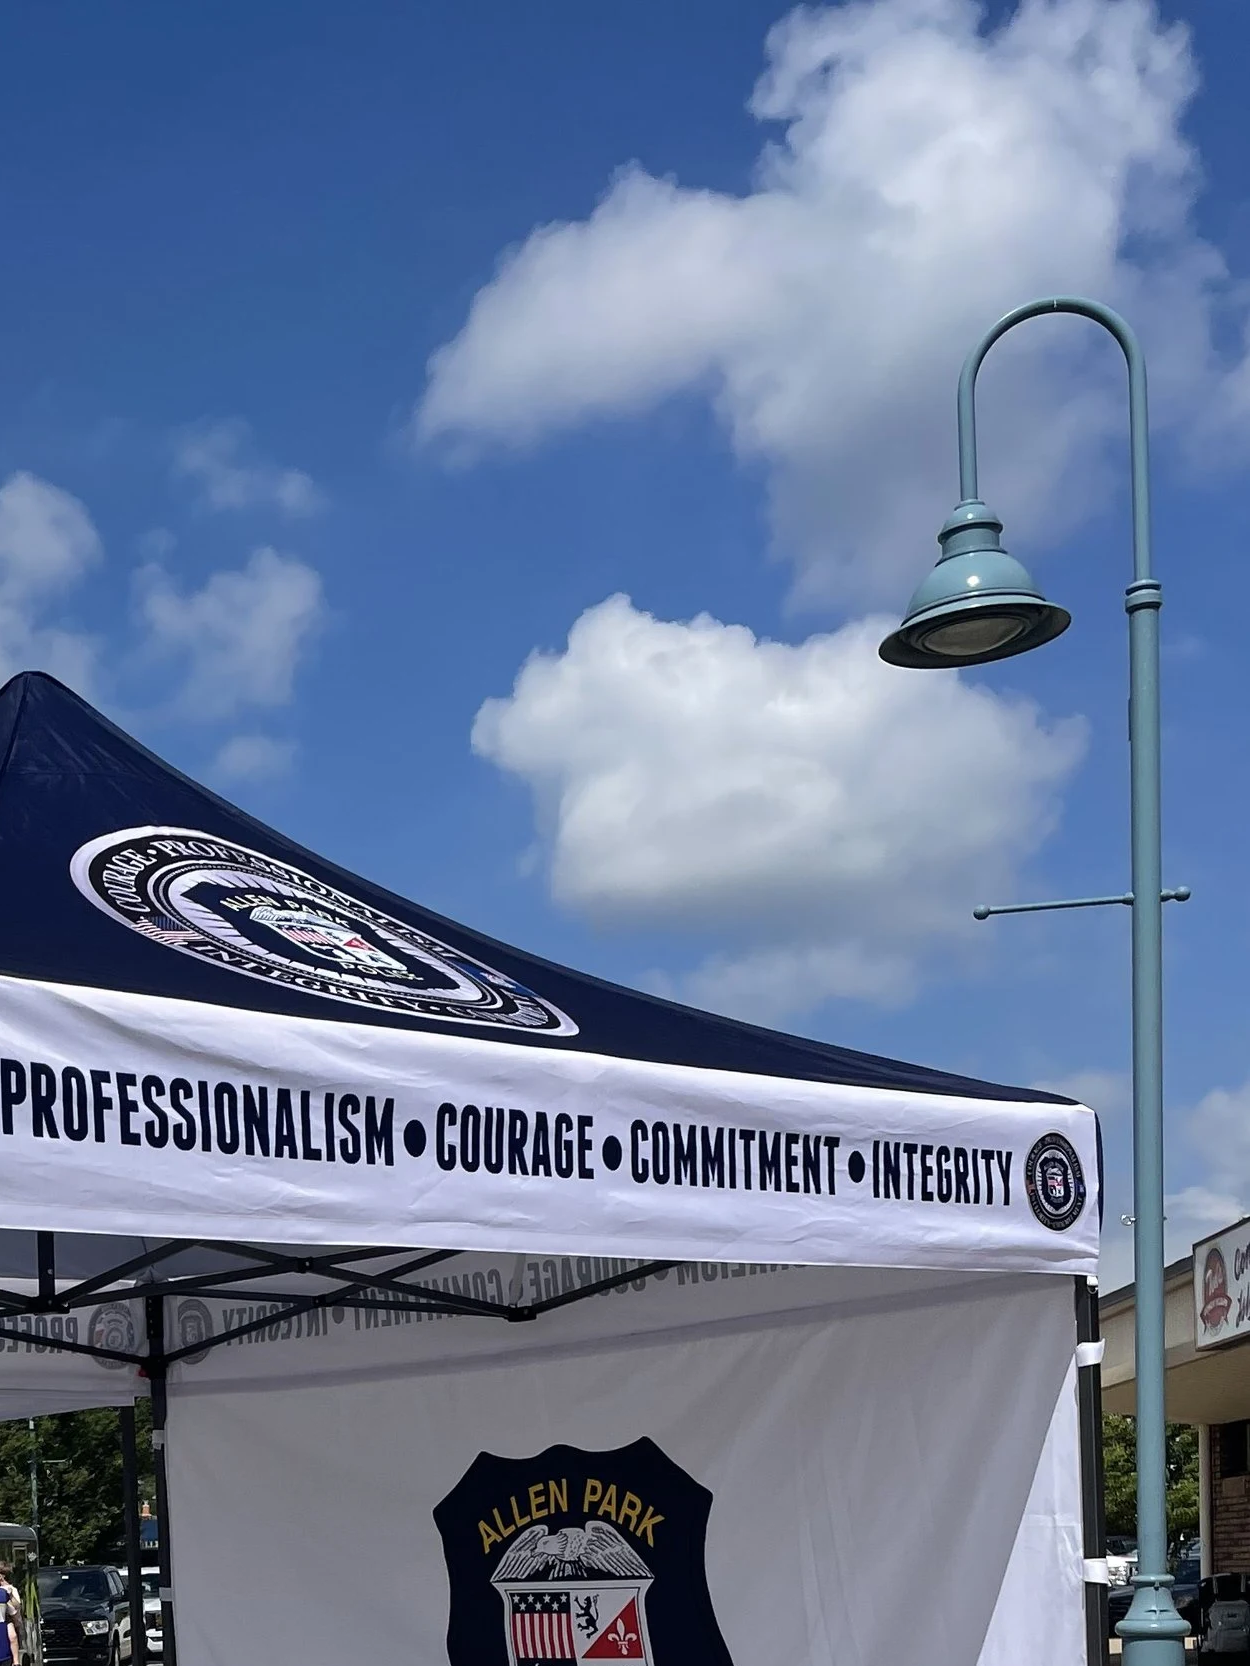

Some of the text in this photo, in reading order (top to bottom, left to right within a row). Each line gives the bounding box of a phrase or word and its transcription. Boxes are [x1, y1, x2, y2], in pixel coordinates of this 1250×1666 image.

[102, 848, 158, 913] COURAGE
[219, 893, 281, 912] ALLEN
[0, 1057, 395, 1167] PROFESSIONALISM
[435, 1101, 595, 1180] COURAGE
[630, 1119, 841, 1196] COMMITMENT
[871, 1140, 1013, 1206] INTEGRITY
[477, 1477, 665, 1555] ALLEN PARK
